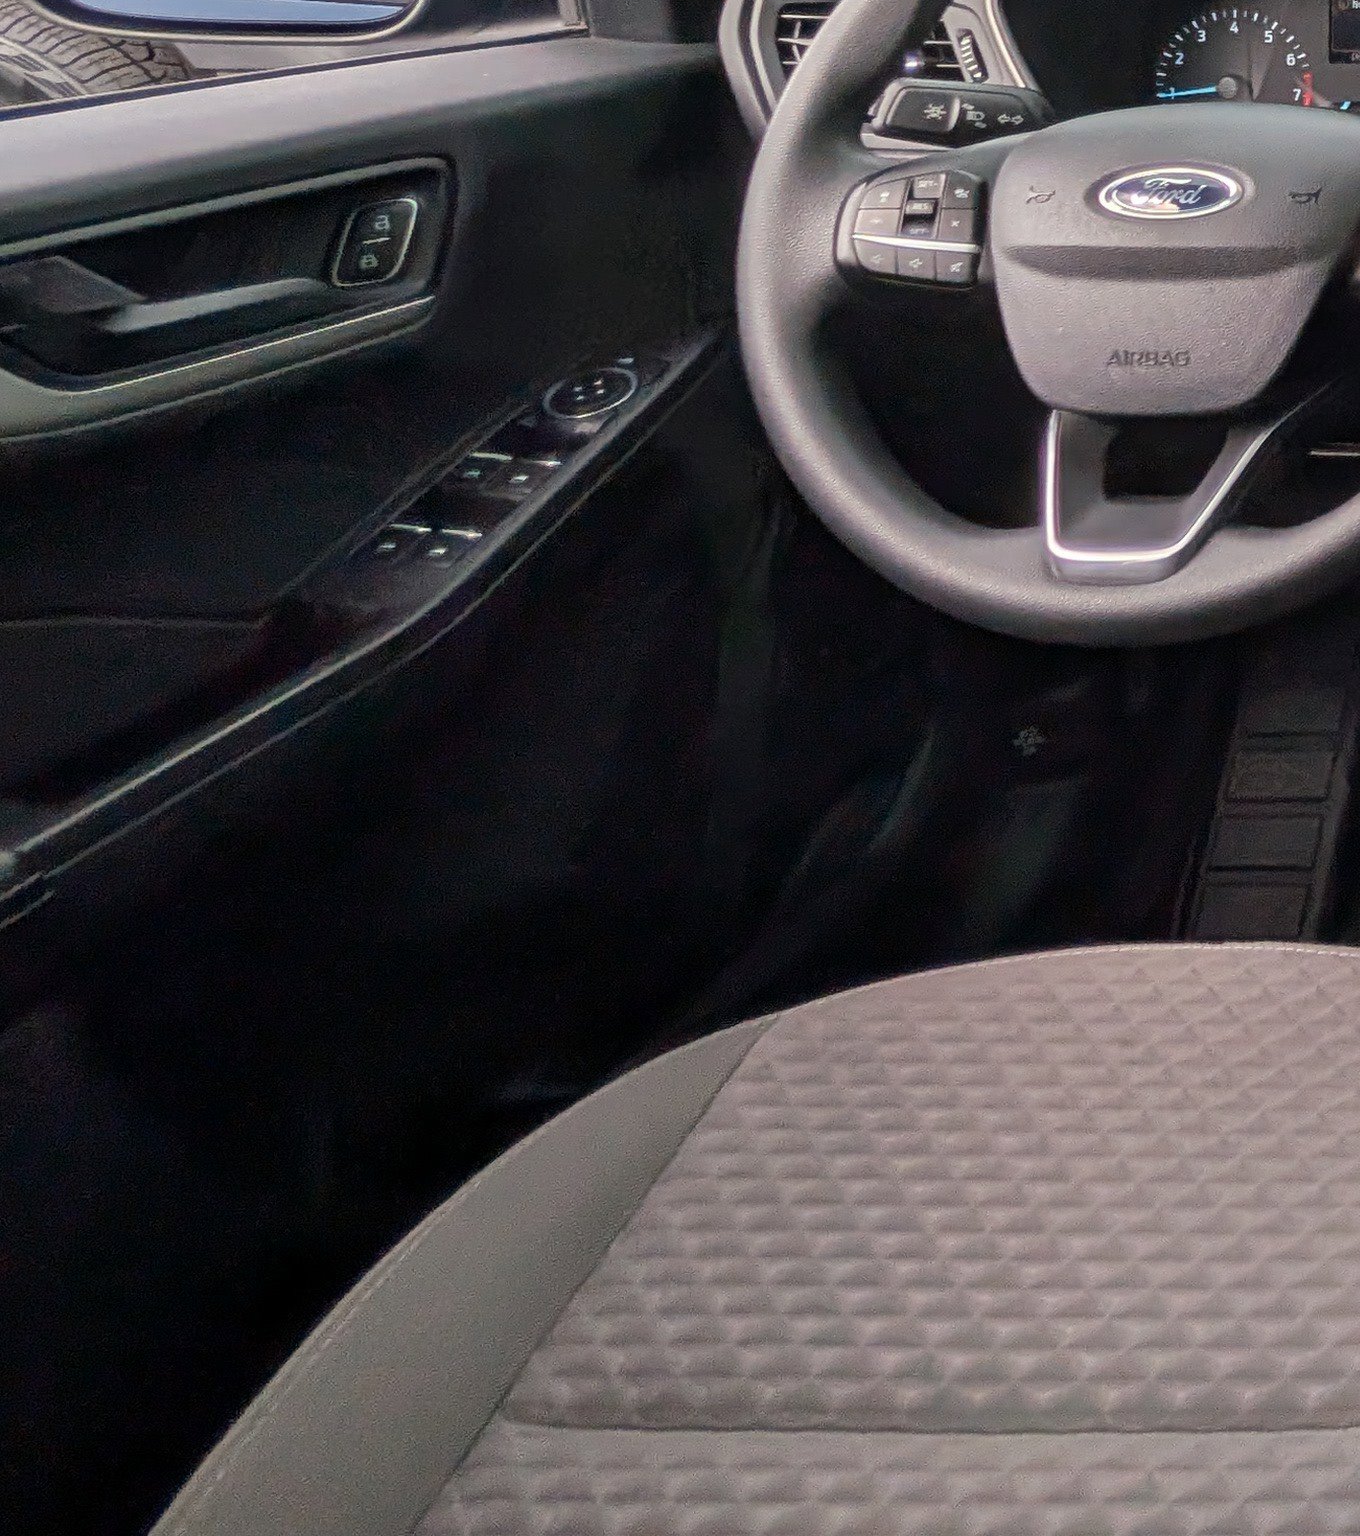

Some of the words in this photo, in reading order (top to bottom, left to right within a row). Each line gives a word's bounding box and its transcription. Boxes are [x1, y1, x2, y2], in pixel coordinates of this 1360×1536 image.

[1229, 22, 1239, 33] 4
[1197, 30, 1206, 42] 3
[1264, 30, 1273, 43] 5
[1174, 52, 1184, 65] 2
[1286, 54, 1296, 66] 6
[1292, 88, 1302, 101] 7
[1142, 178, 1207, 205] Ford
[1107, 350, 1191, 366] AIRBAG
